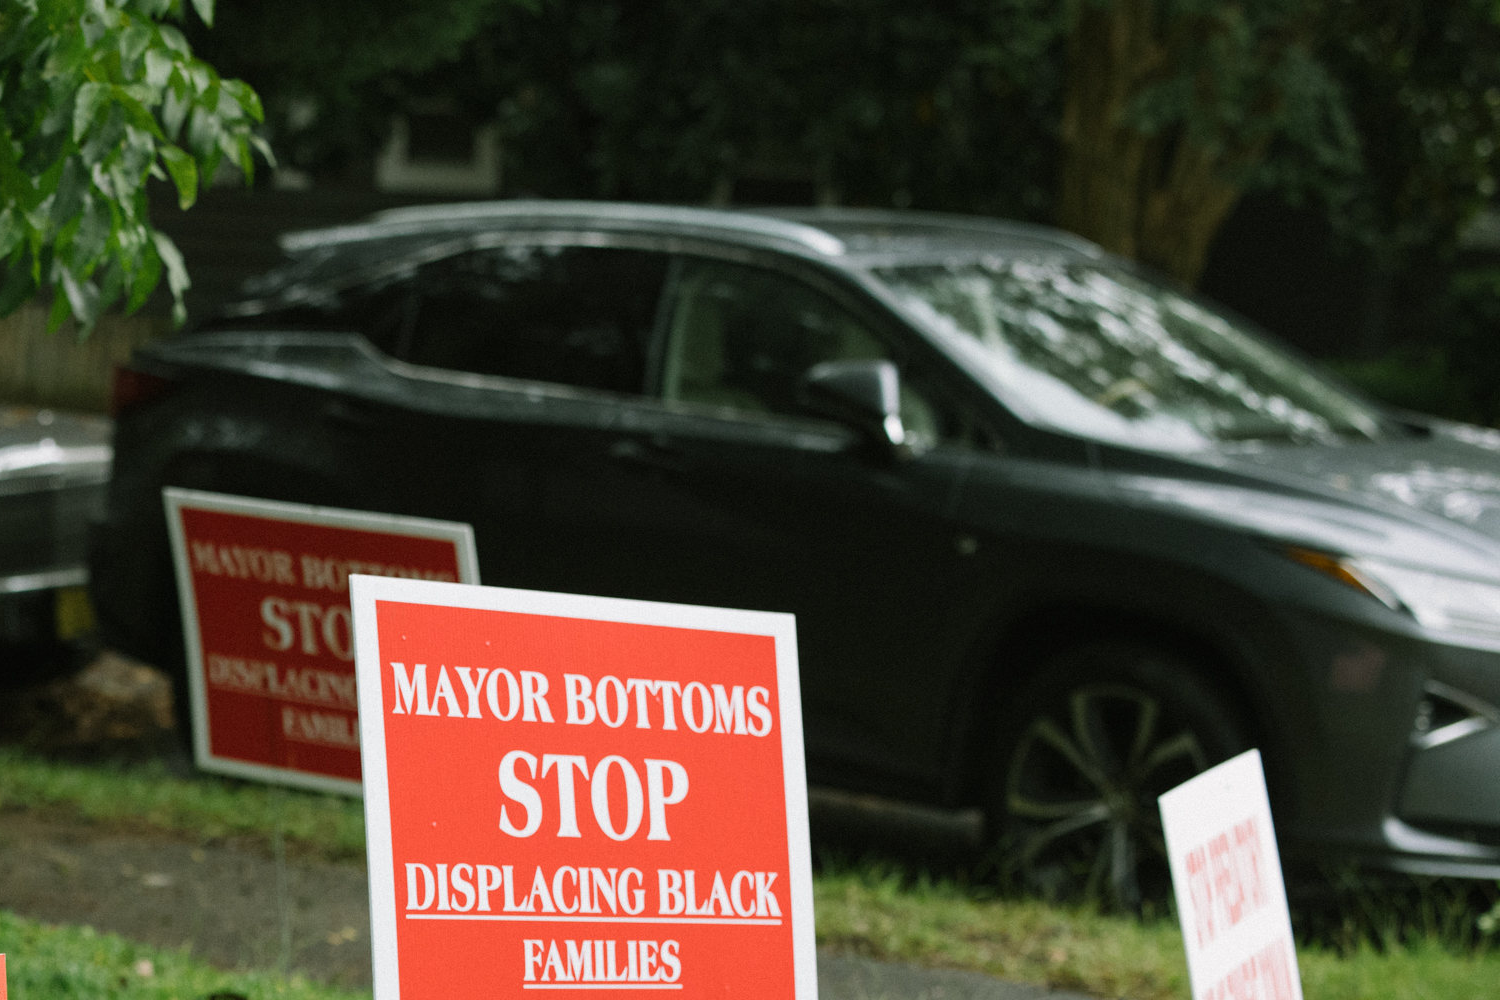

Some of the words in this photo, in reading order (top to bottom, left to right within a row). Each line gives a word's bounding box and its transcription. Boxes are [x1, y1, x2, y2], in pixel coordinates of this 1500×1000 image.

[192, 541, 296, 586] MAYOR
[260, 596, 354, 661] STO
[206, 653, 358, 707] DISPLACIN
[390, 662, 555, 723] MAYOR
[563, 673, 773, 738] BOTTOMS
[499, 750, 690, 842] STOP
[404, 862, 646, 916] DISPLACING
[657, 868, 783, 918] BLACK
[522, 939, 682, 984] FAMILIES
